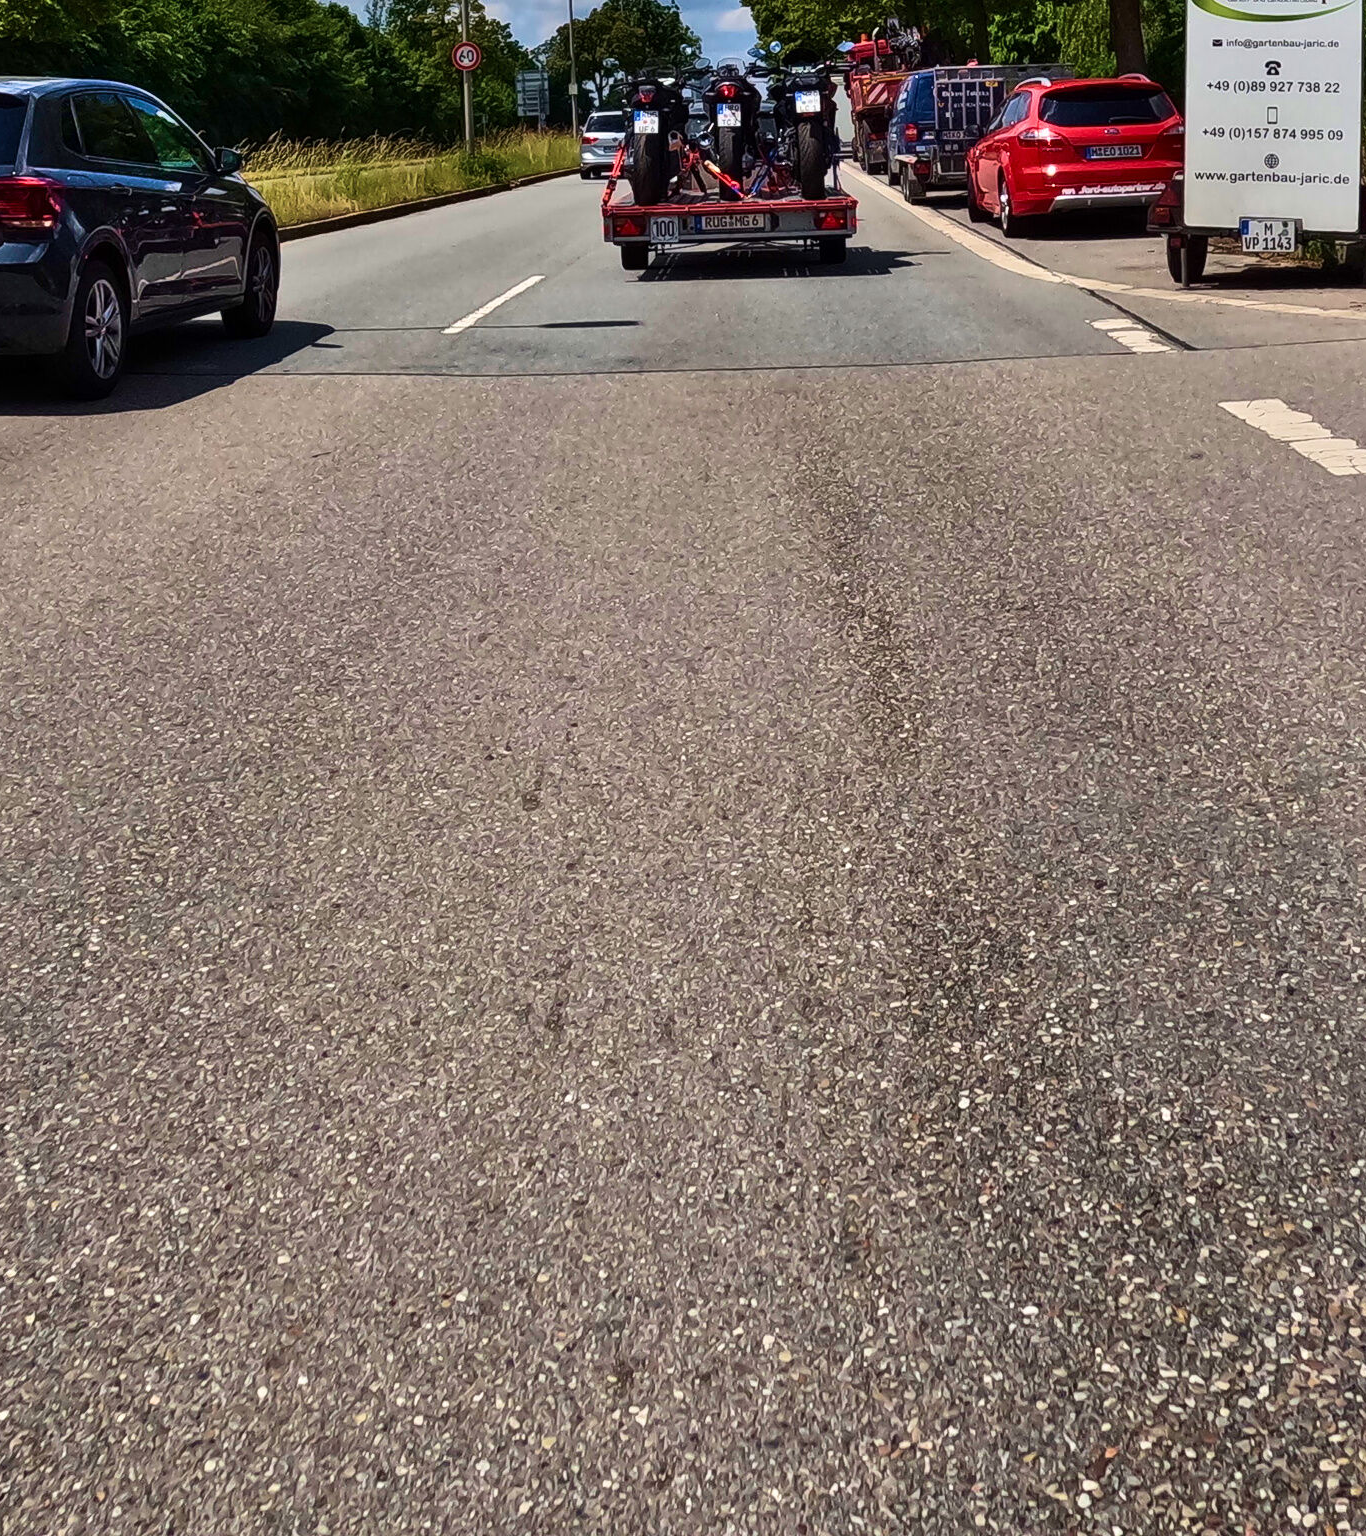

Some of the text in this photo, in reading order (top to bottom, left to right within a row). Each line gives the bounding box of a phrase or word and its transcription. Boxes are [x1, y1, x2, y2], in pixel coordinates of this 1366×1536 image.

[1226, 39, 1340, 49] info@gartenbau-jaric.de
[458, 49, 475, 63] 60
[1207, 81, 1340, 94] +49 (0)89 927 738 22
[1202, 127, 1344, 141] +49 (0)157 874 995 09
[1194, 171, 1350, 185] www.gartenbau-jaric.de
[653, 220, 675, 237] 100
[704, 215, 759, 228] RUG MG 6
[1264, 223, 1273, 235] M
[1244, 237, 1292, 251] VP 1143
